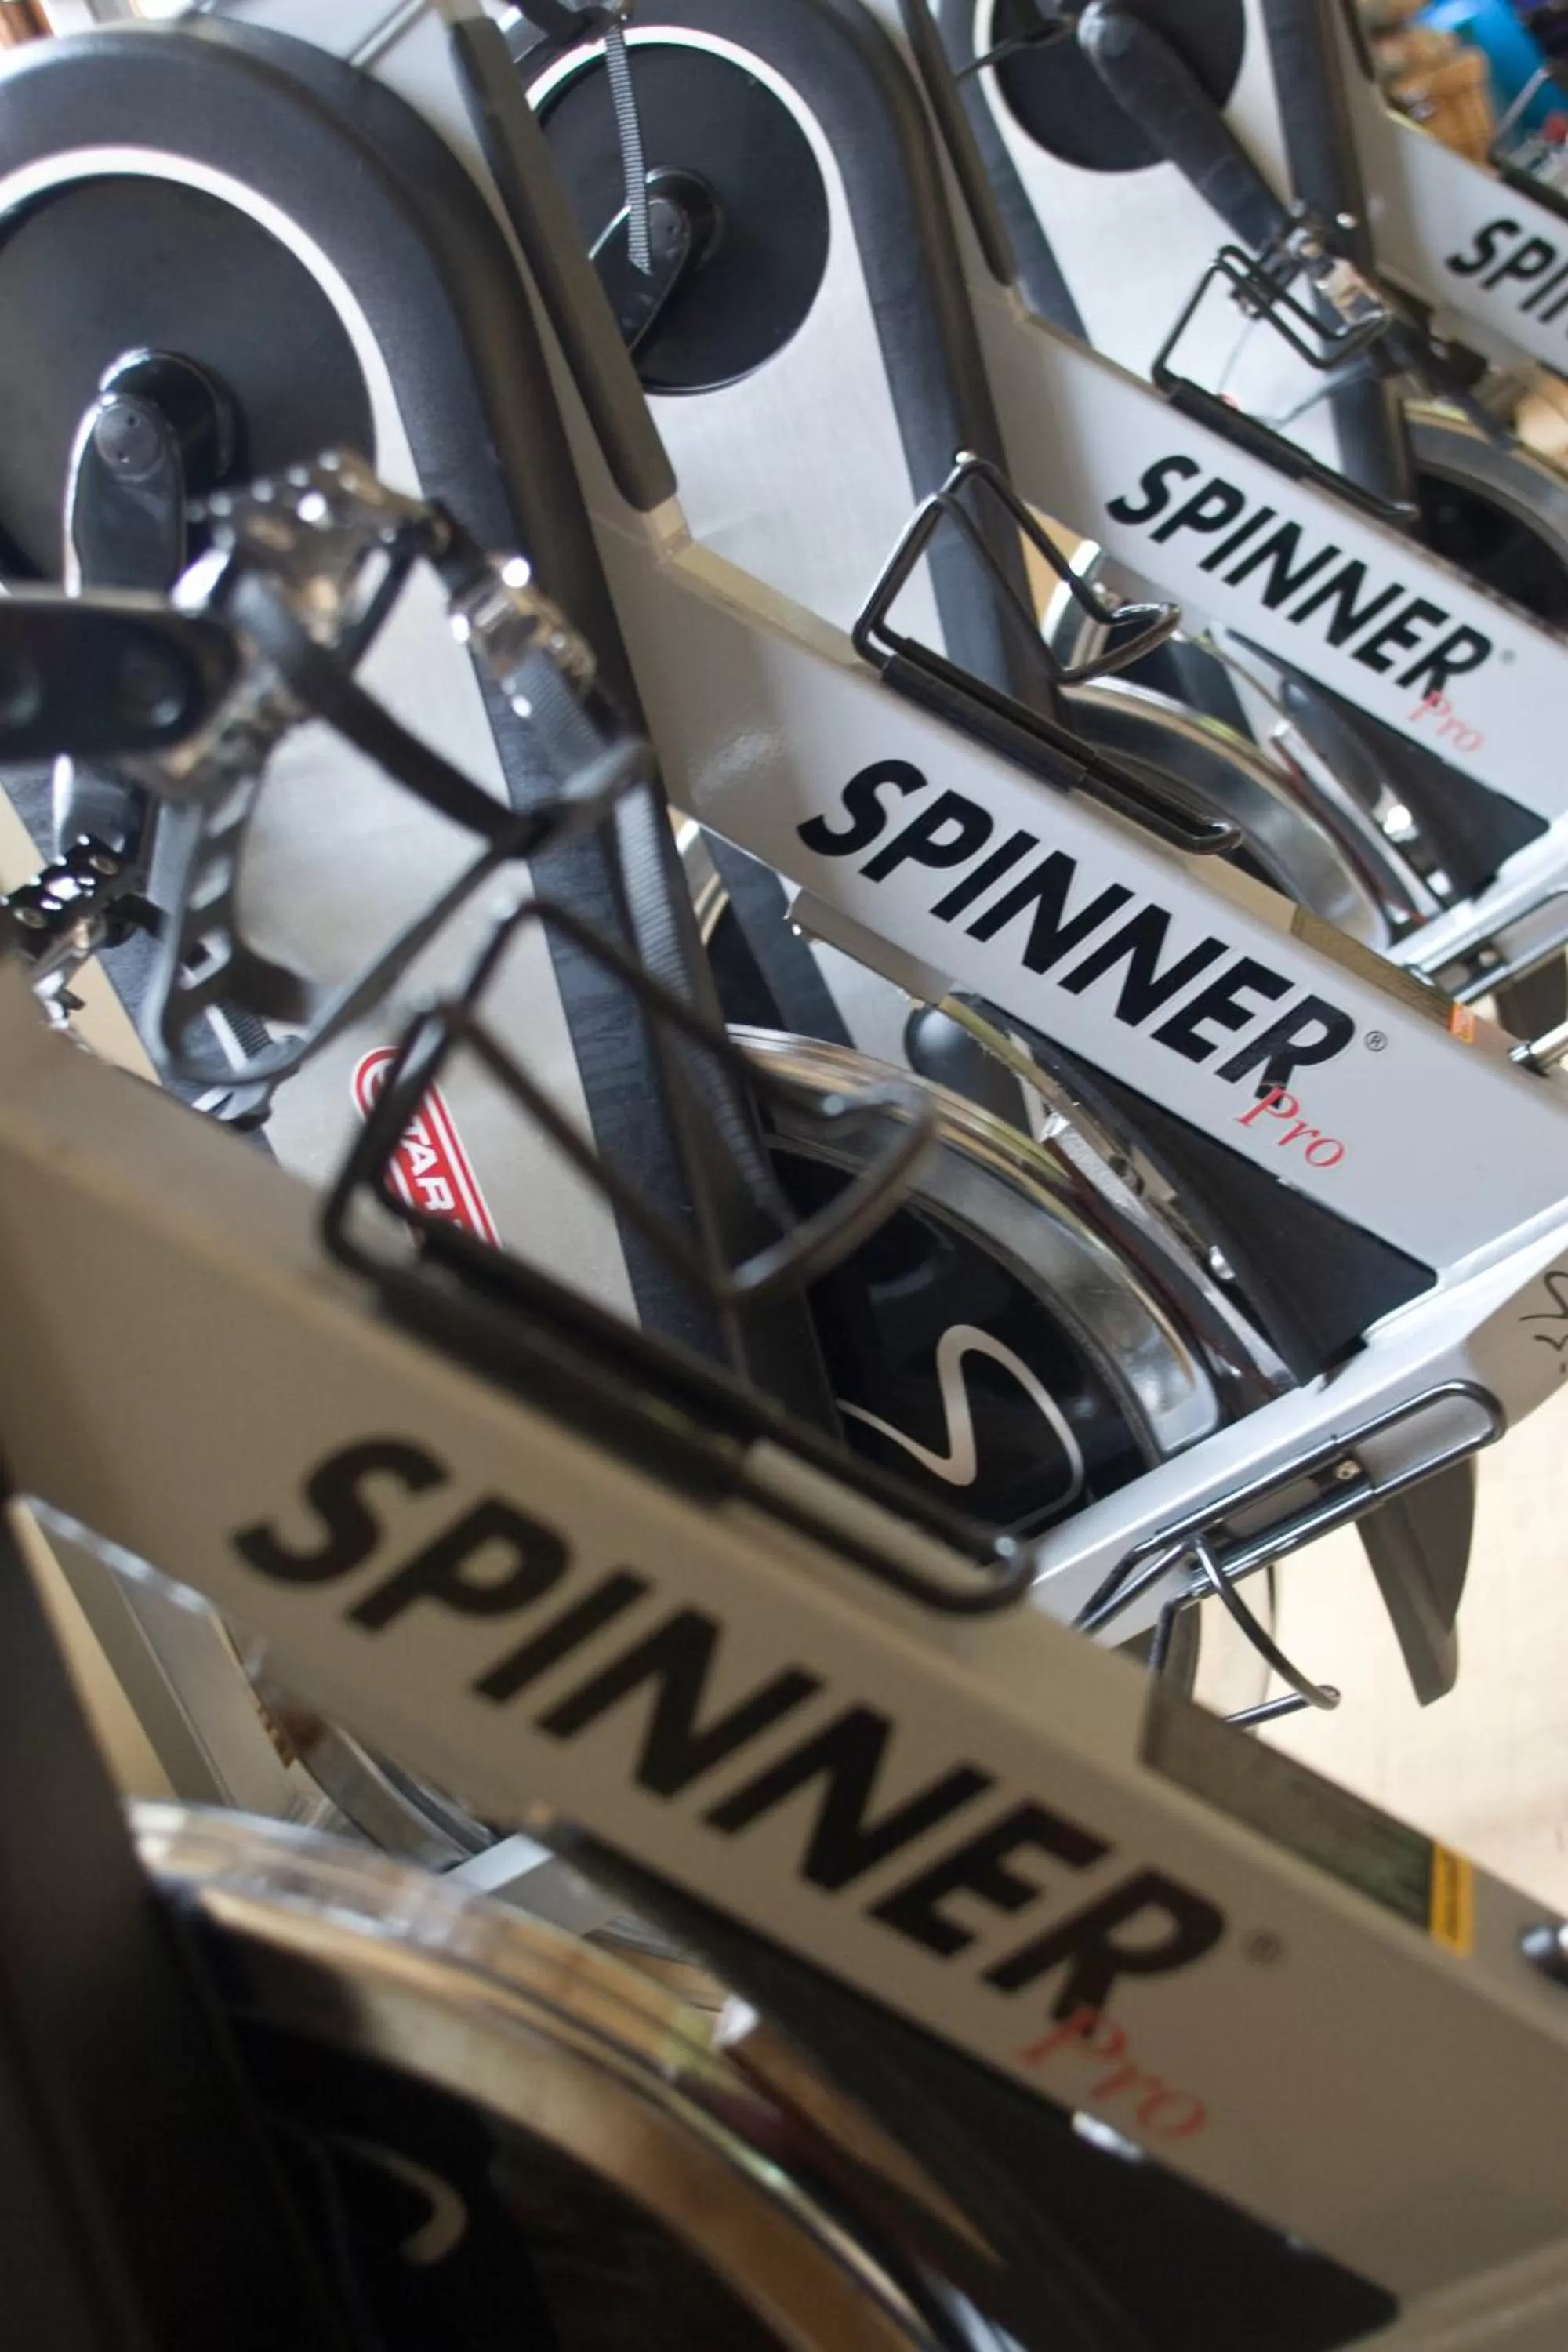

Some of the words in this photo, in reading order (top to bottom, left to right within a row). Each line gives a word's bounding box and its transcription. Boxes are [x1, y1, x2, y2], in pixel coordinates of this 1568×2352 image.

[1105, 455, 1492, 706] SPINNER
[1406, 691, 1484, 753] Pro
[796, 759, 1355, 1109] SPINNER
[401, 1115, 456, 1211] TAR
[1235, 1086, 1345, 1167] Pro
[230, 1436, 1225, 2034] SPINNER
[1014, 2007, 1206, 2143] Pro
